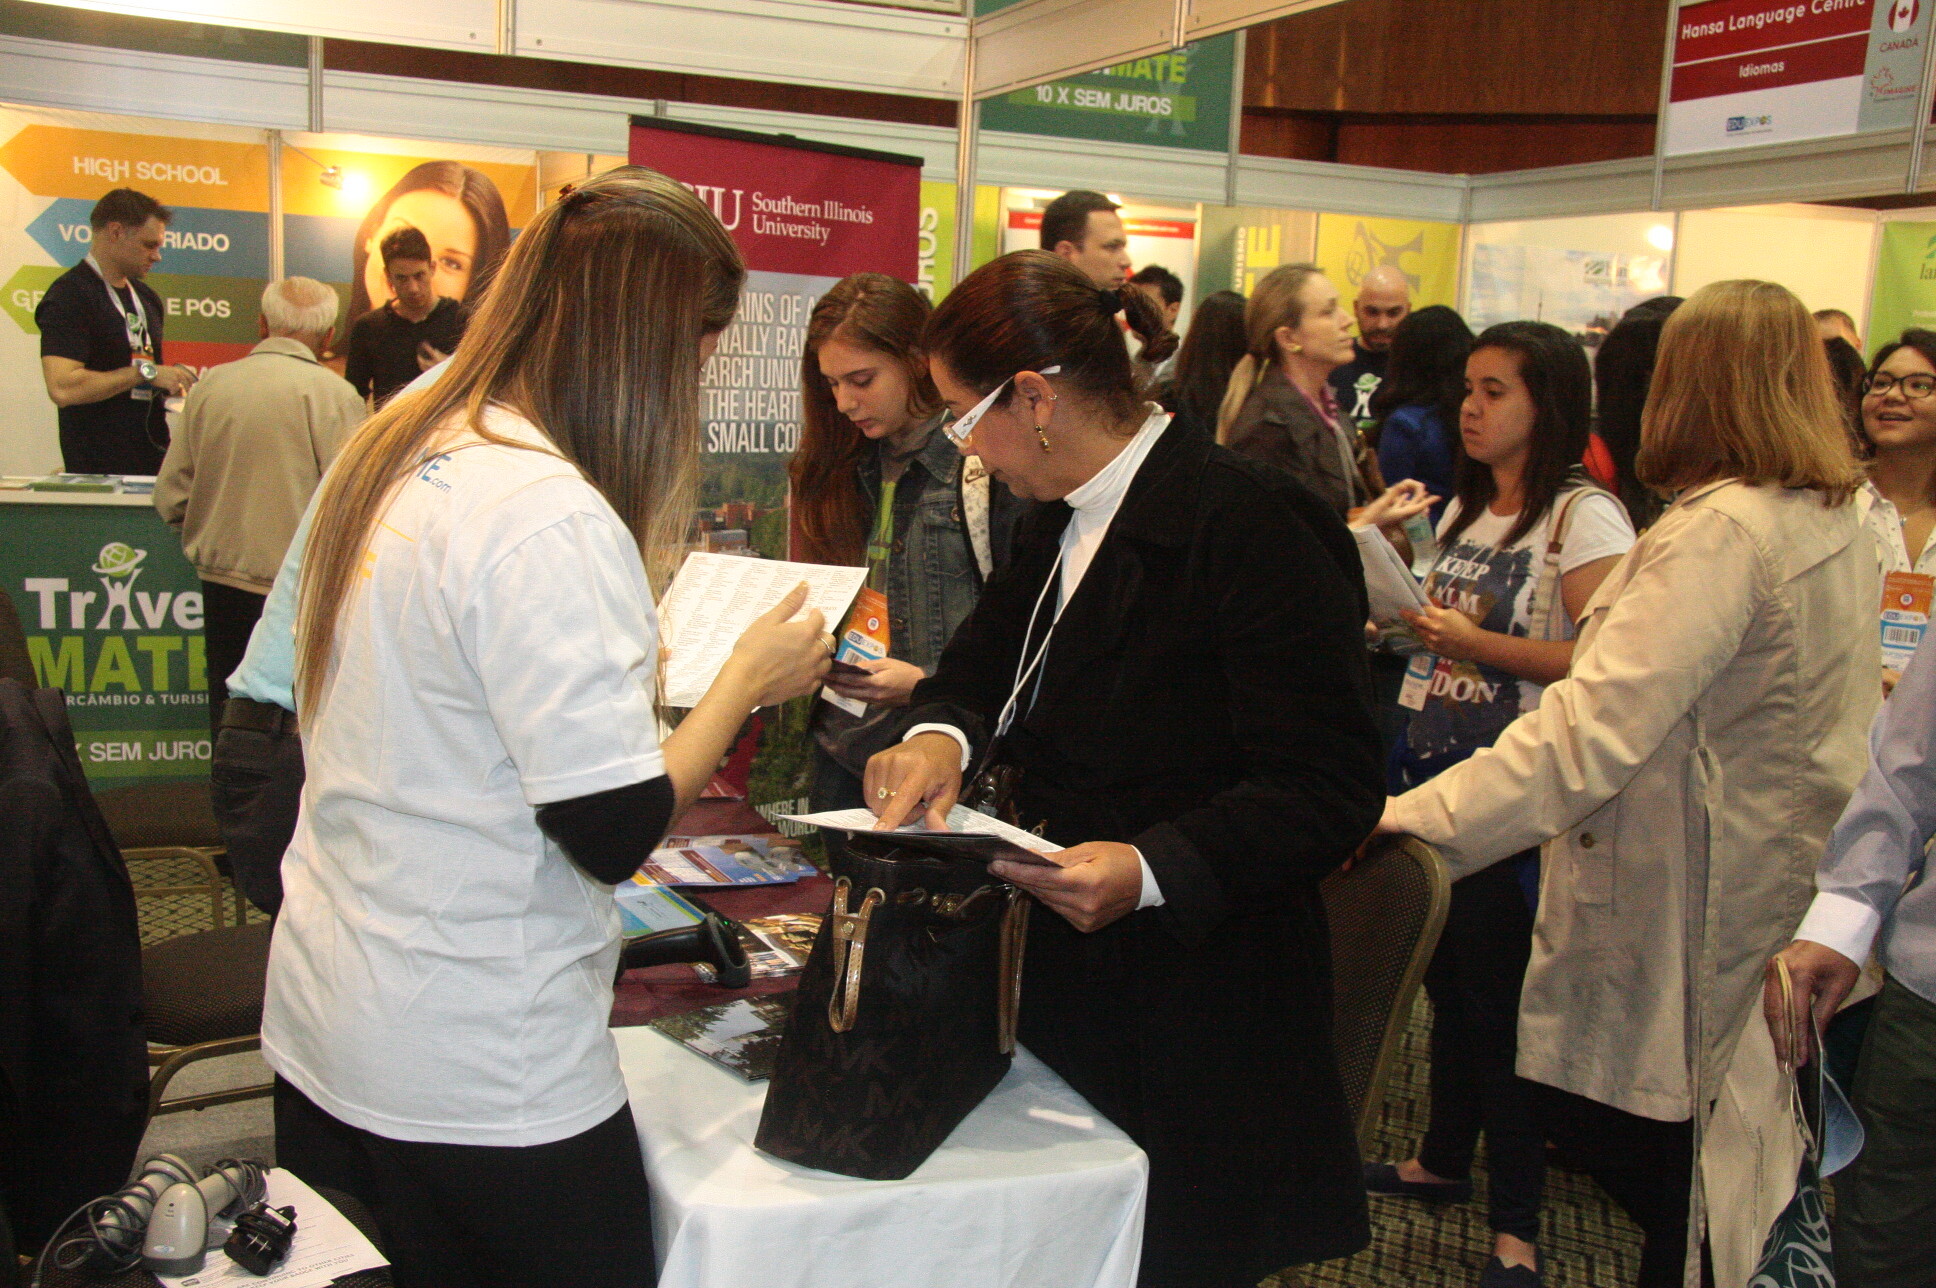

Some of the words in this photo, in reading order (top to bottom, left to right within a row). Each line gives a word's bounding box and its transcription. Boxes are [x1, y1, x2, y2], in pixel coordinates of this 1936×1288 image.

[1681, 20, 1724, 40] Hansa
[1729, 2, 1805, 31] Language
[1739, 60, 1785, 78] Idiomas
[1036, 85, 1052, 103] 10
[1057, 86, 1070, 105] X
[1074, 88, 1111, 108] SEM
[1114, 93, 1172, 115] JUROS
[73, 156, 129, 182] HIGH
[136, 161, 228, 186] SCHOOL
[752, 191, 821, 218] Southern
[824, 201, 873, 224] Illinois
[753, 214, 831, 246] University
[166, 298, 181, 315] E
[185, 297, 231, 318] PÓS
[781, 294, 801, 325] OF
[706, 388, 739, 420] THE
[745, 390, 800, 421] HEART
[708, 421, 769, 453] SMALL
[1435, 555, 1490, 581] KEEP
[145, 694, 156, 705] &
[1431, 670, 1501, 704] DON
[89, 742, 142, 762] SEM
[148, 740, 212, 761] JURO
